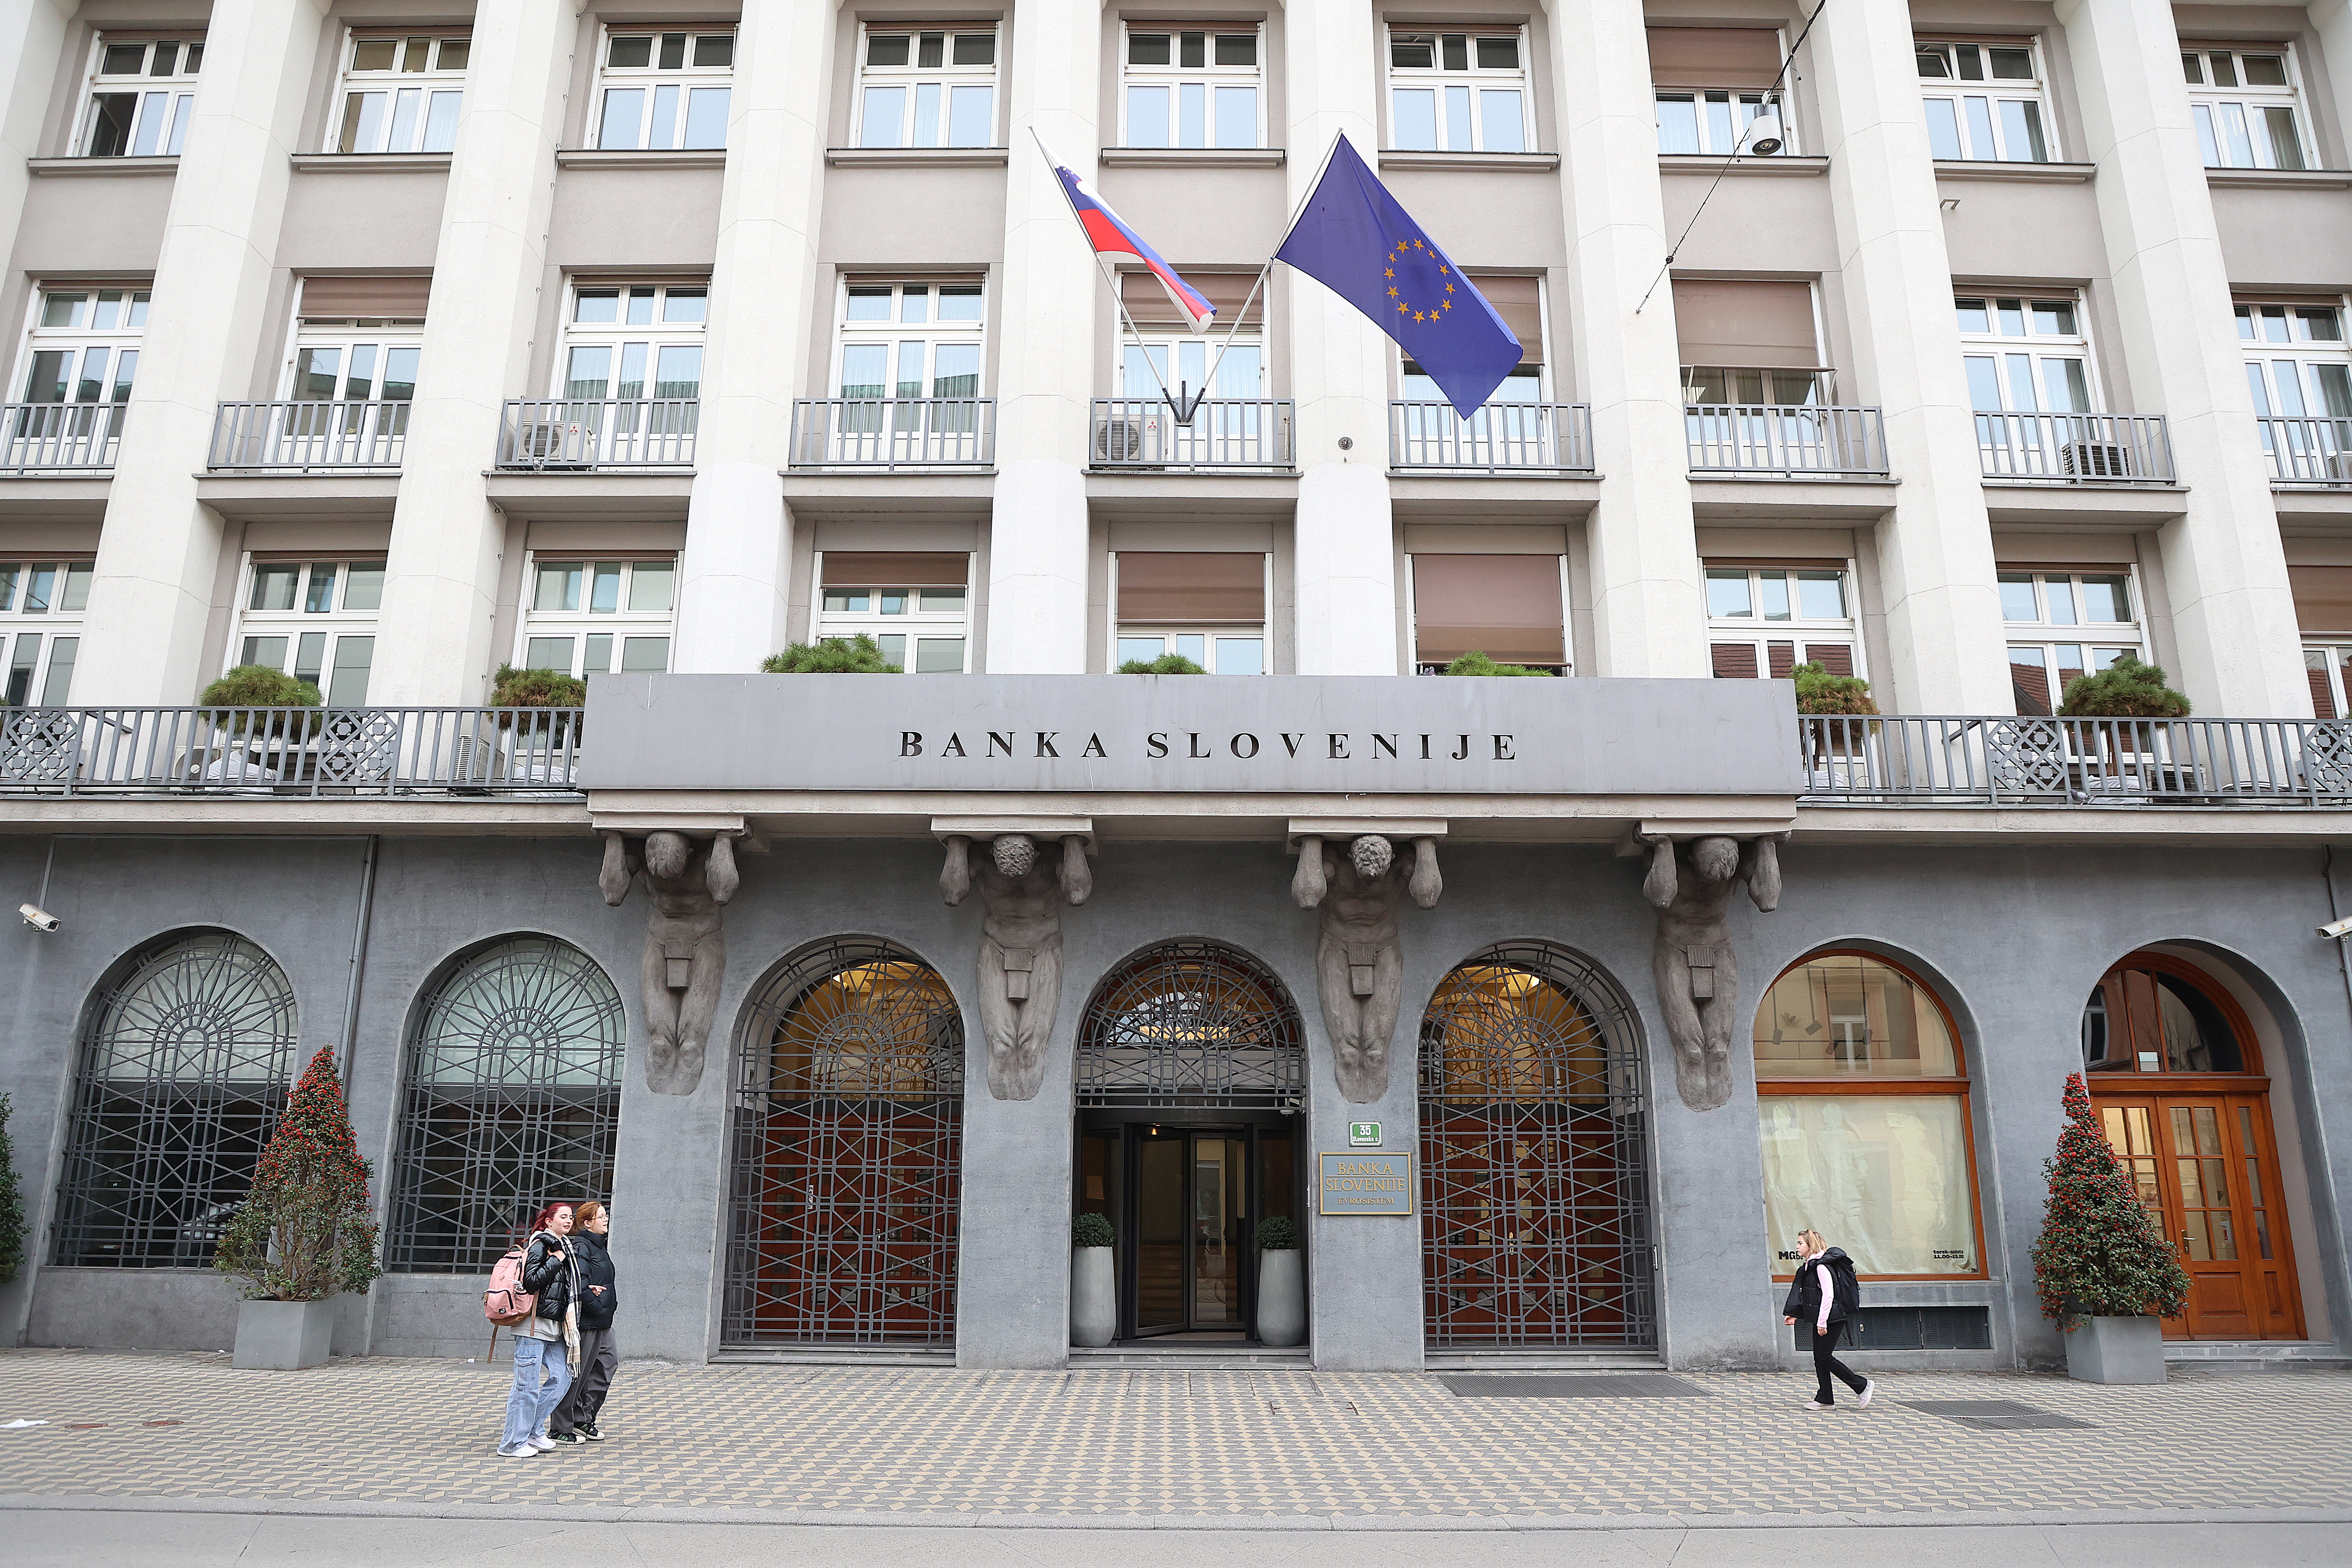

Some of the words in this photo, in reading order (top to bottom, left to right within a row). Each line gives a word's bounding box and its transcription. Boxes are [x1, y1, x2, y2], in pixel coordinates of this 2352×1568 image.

[898, 731, 1108, 758] BANKA
[1147, 732, 1516, 760] SLOVENIJE
[1360, 1125, 1371, 1135] 35
[1337, 1163, 1393, 1175] BANKA
[1326, 1179, 1406, 1191] SLOVENIJE
